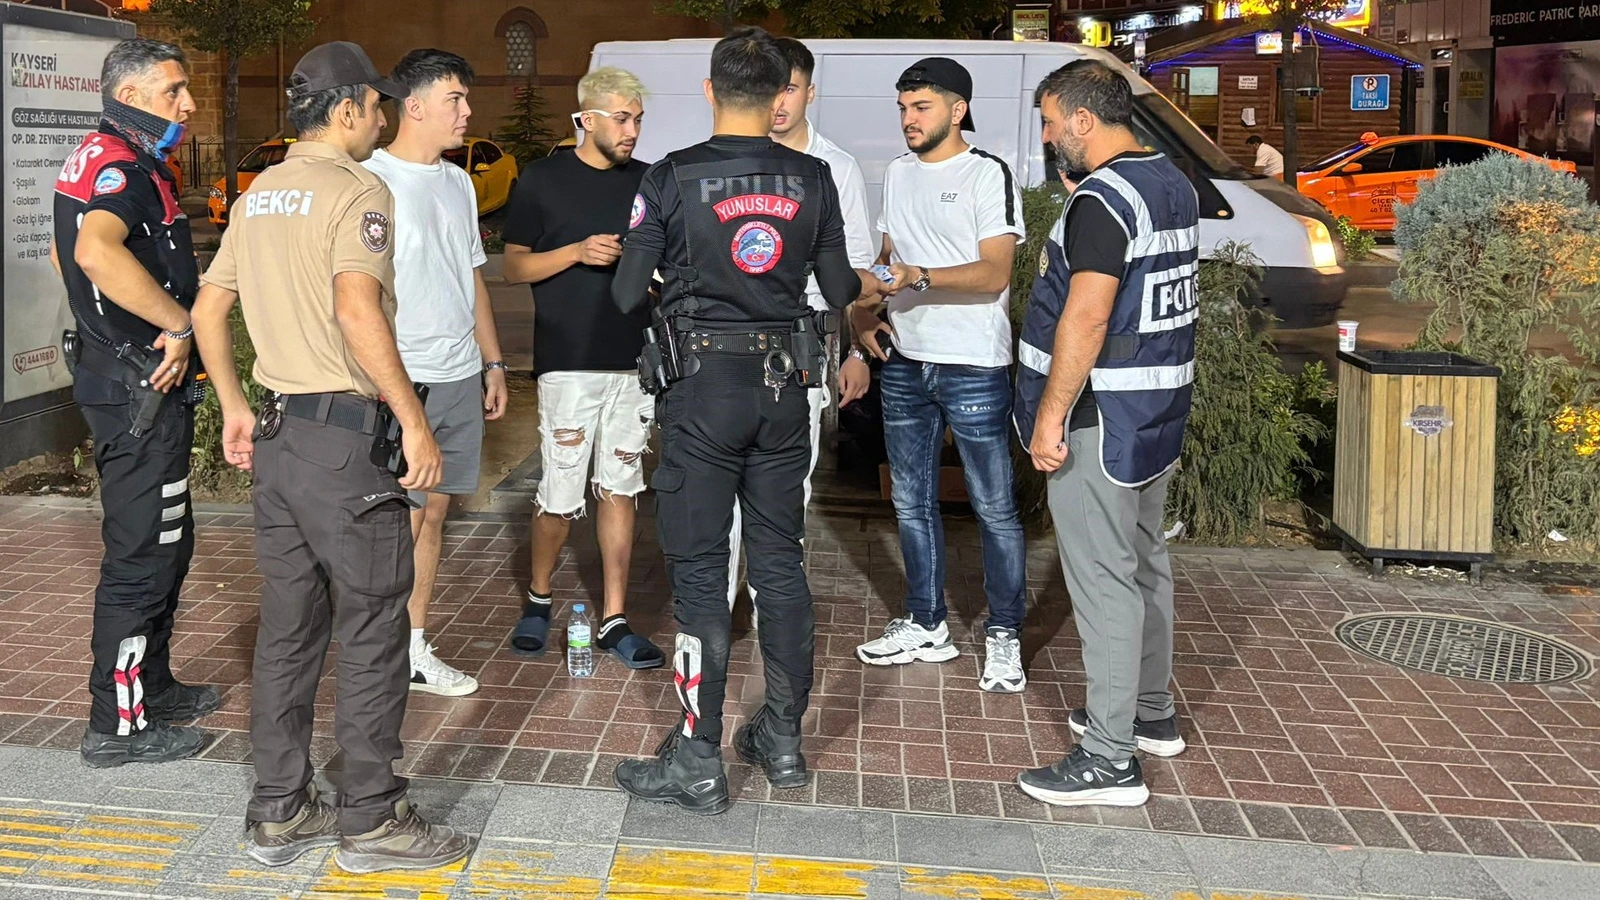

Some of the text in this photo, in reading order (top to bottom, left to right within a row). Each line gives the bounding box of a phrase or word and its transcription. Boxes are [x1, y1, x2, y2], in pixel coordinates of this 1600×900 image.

[1490, 4, 1600, 26] FREDERIC PATRIC PAR
[11, 52, 57, 71] KAYSERİ
[11, 70, 100, 93] ZILAY HASTANE
[14, 111, 28, 123] GÖZ
[30, 111, 58, 125] SAĞLIĞI
[58, 115, 67, 125] VE
[12, 133, 25, 144] OP.
[26, 133, 38, 144] DR.
[39, 133, 67, 145] ZEYNEP
[15, 159, 43, 168] Katarakt
[245, 189, 313, 218] BEKÇİ
[940, 192, 958, 201] EA7
[717, 197, 794, 220] YUNUSLAR
[16, 215, 29, 225] Göz
[16, 233, 29, 244] Göz
